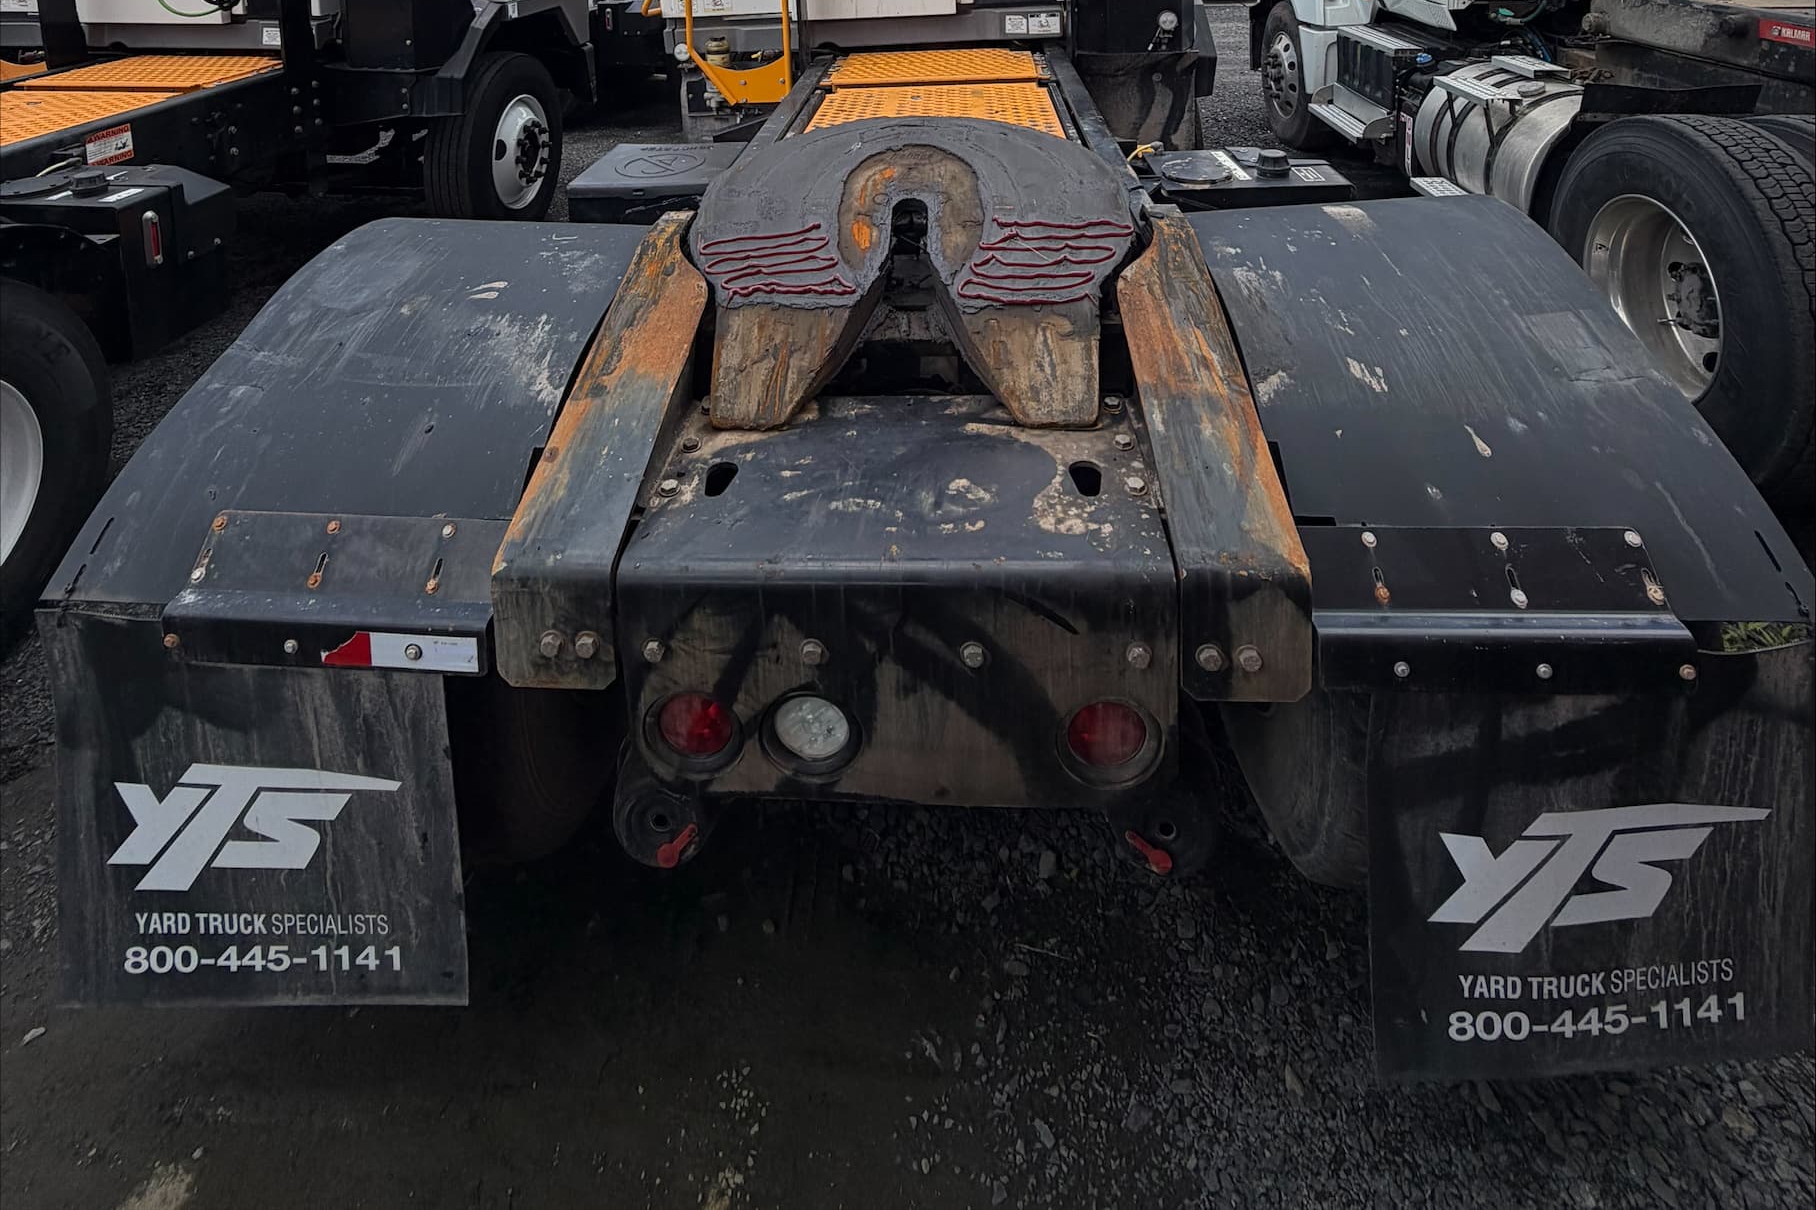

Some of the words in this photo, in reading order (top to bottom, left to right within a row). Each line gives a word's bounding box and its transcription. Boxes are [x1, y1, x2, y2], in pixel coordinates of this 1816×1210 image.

[1780, 27, 1811, 42] KALMAR
[106, 763, 402, 891] YTS
[1426, 803, 1773, 953] YTS
[135, 912, 191, 935] YARD
[195, 913, 268, 936] TRUCK
[271, 914, 390, 936] SPECIALISTS
[123, 945, 402, 974] 800-445-1141
[1457, 974, 1522, 1000] YARD
[1527, 972, 1606, 1000] TRUCK
[1610, 957, 1734, 992] SPECIALISTS
[1448, 992, 1746, 1042] 800-445-1141
